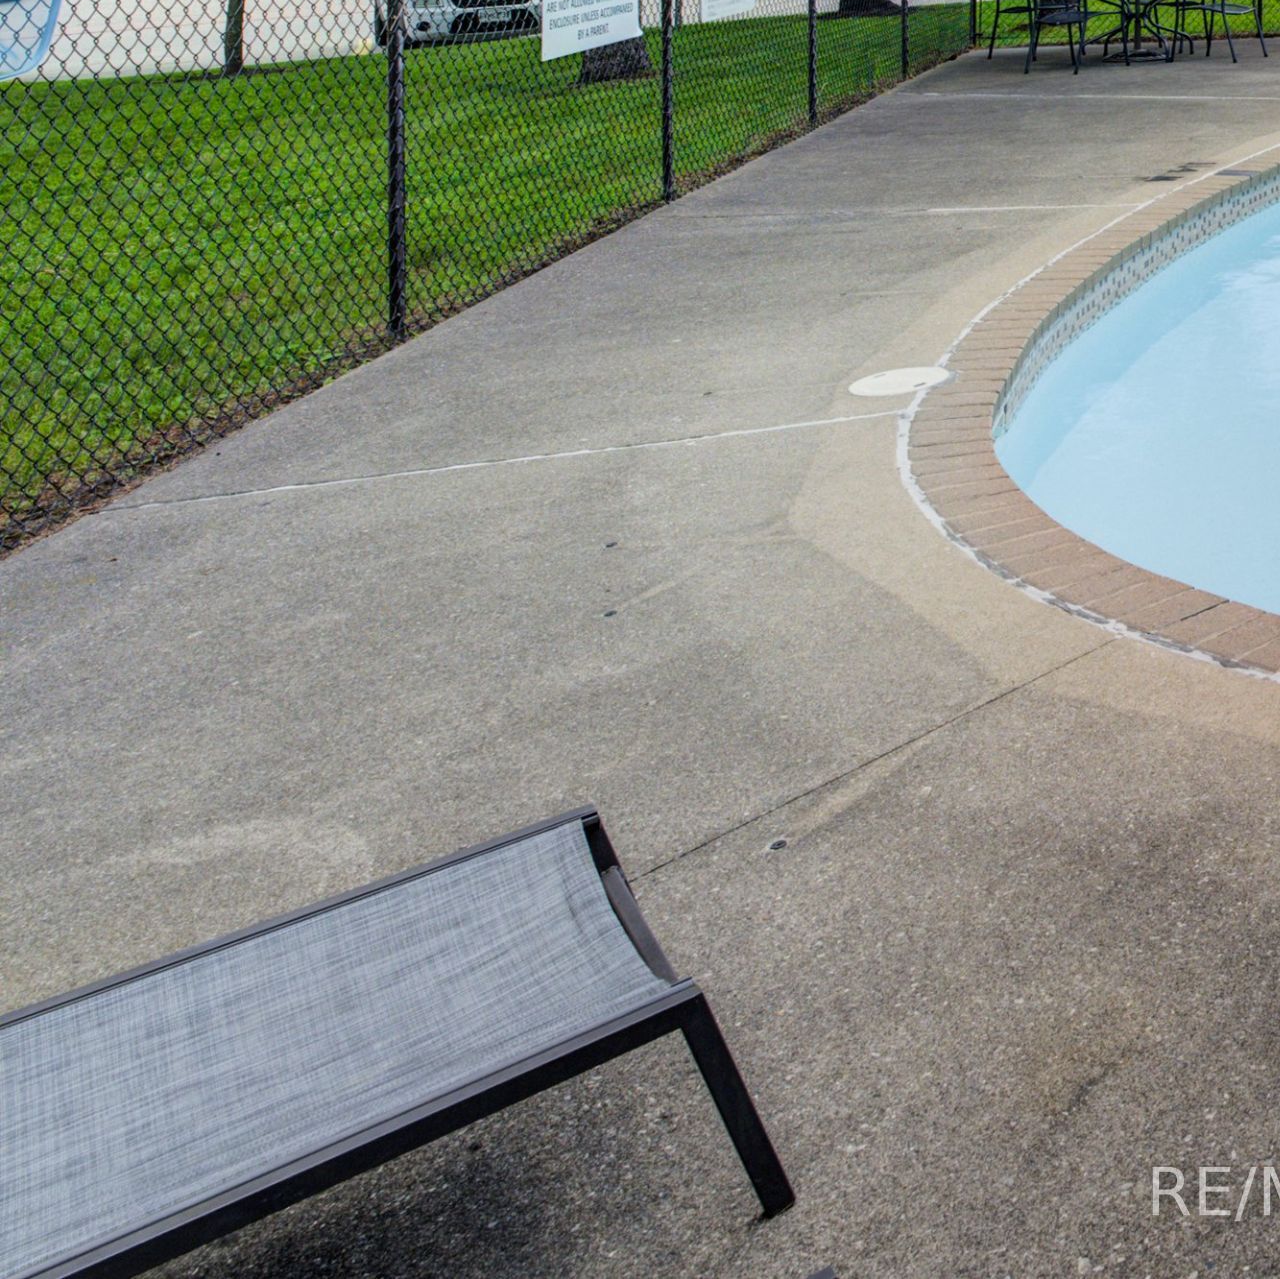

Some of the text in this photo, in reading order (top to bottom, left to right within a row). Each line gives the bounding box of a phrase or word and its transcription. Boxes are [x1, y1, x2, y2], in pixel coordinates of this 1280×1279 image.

[547, 1, 557, 13] ARE
[558, 0, 569, 10] NOT
[549, 14, 579, 30] ENCLOSURE
[580, 9, 600, 23] UNLESS
[577, 29, 584, 40] BY
